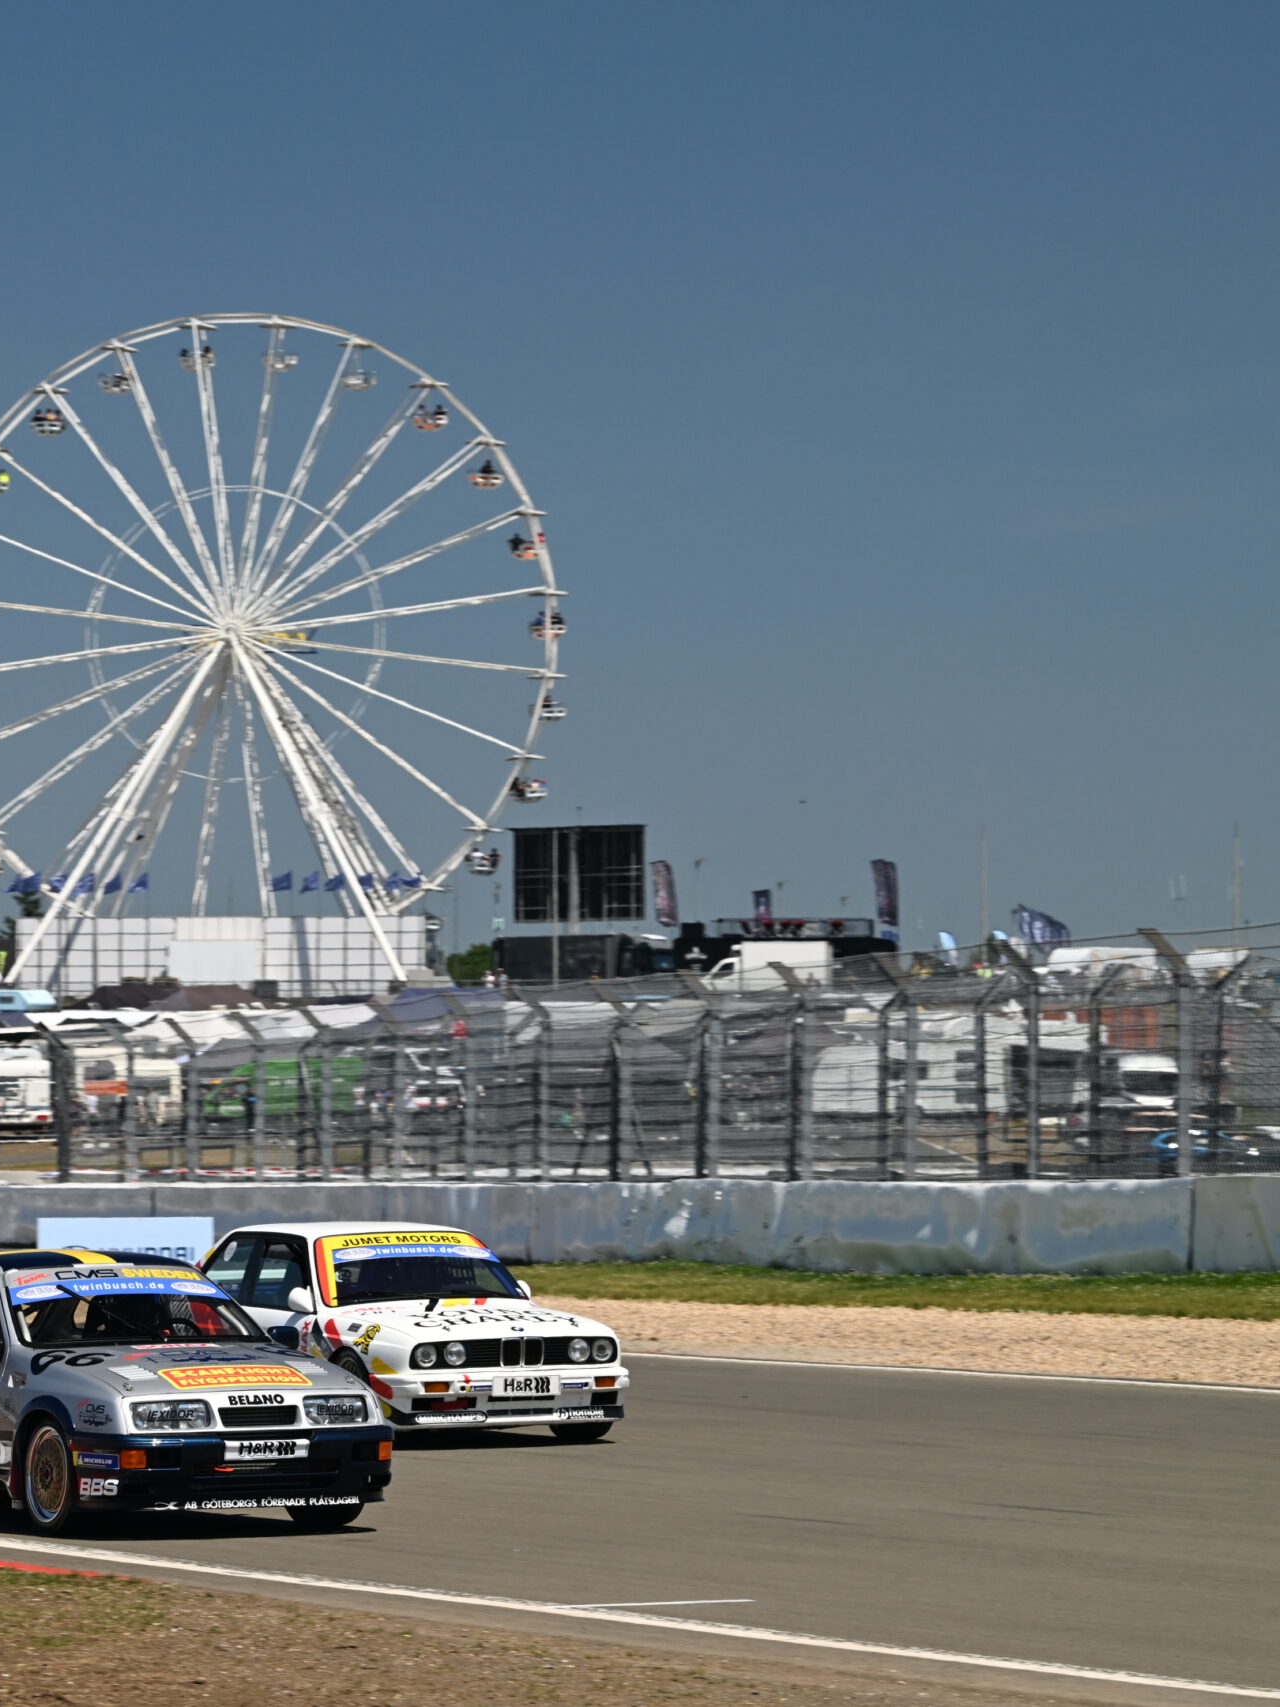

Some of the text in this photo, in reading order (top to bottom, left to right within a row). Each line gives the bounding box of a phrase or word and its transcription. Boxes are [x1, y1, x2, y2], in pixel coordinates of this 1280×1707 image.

[341, 1234, 462, 1247] JUMET MOTORS
[377, 1245, 454, 1255] twinbusch.de
[55, 1268, 119, 1280] CMS
[121, 1268, 202, 1281] SWEDEN
[73, 1280, 165, 1292] twinbusch.de
[30, 1349, 115, 1375] 66
[178, 1375, 303, 1386] FLYGSPEDITION
[503, 1378, 533, 1392] H&R
[228, 1394, 284, 1406] BELANO
[239, 1441, 275, 1455] H&R
[83, 1457, 113, 1465] MICHELIN
[79, 1478, 120, 1496] BBS
[184, 1501, 198, 1510] AB
[202, 1498, 257, 1509] GÖTEBORGS
[261, 1496, 306, 1507] FÖRENADE
